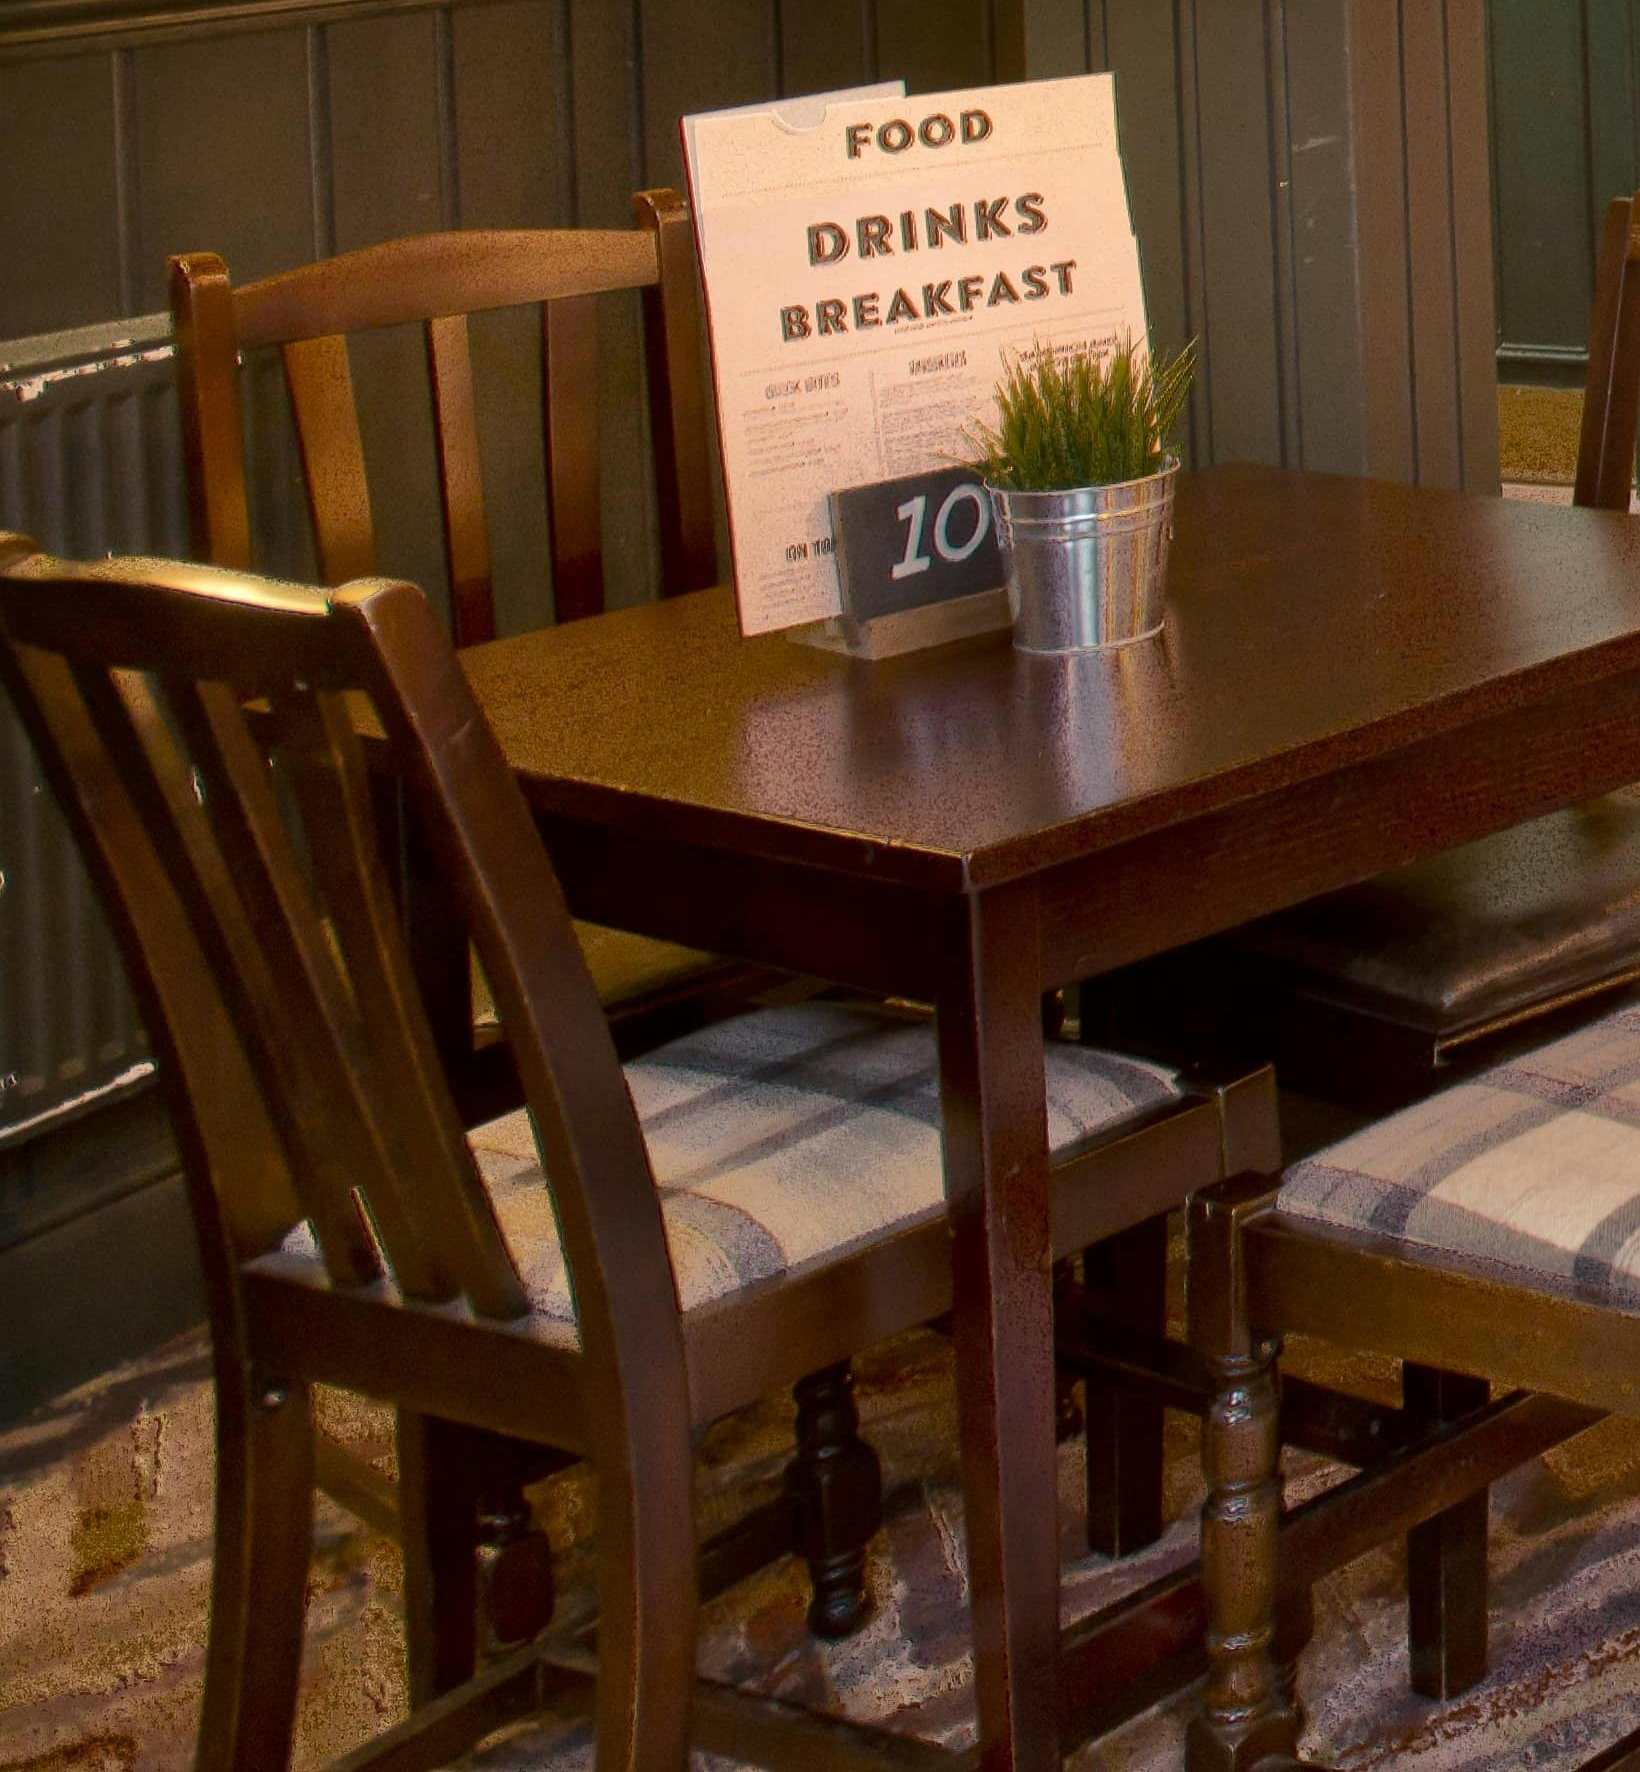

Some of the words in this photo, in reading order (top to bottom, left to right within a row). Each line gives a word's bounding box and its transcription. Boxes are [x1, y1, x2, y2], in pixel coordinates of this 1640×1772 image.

[845, 109, 994, 159] FOOD
[806, 191, 1050, 268] DRINKS
[779, 259, 1078, 343] BREAKFAST
[891, 482, 990, 581] 10
